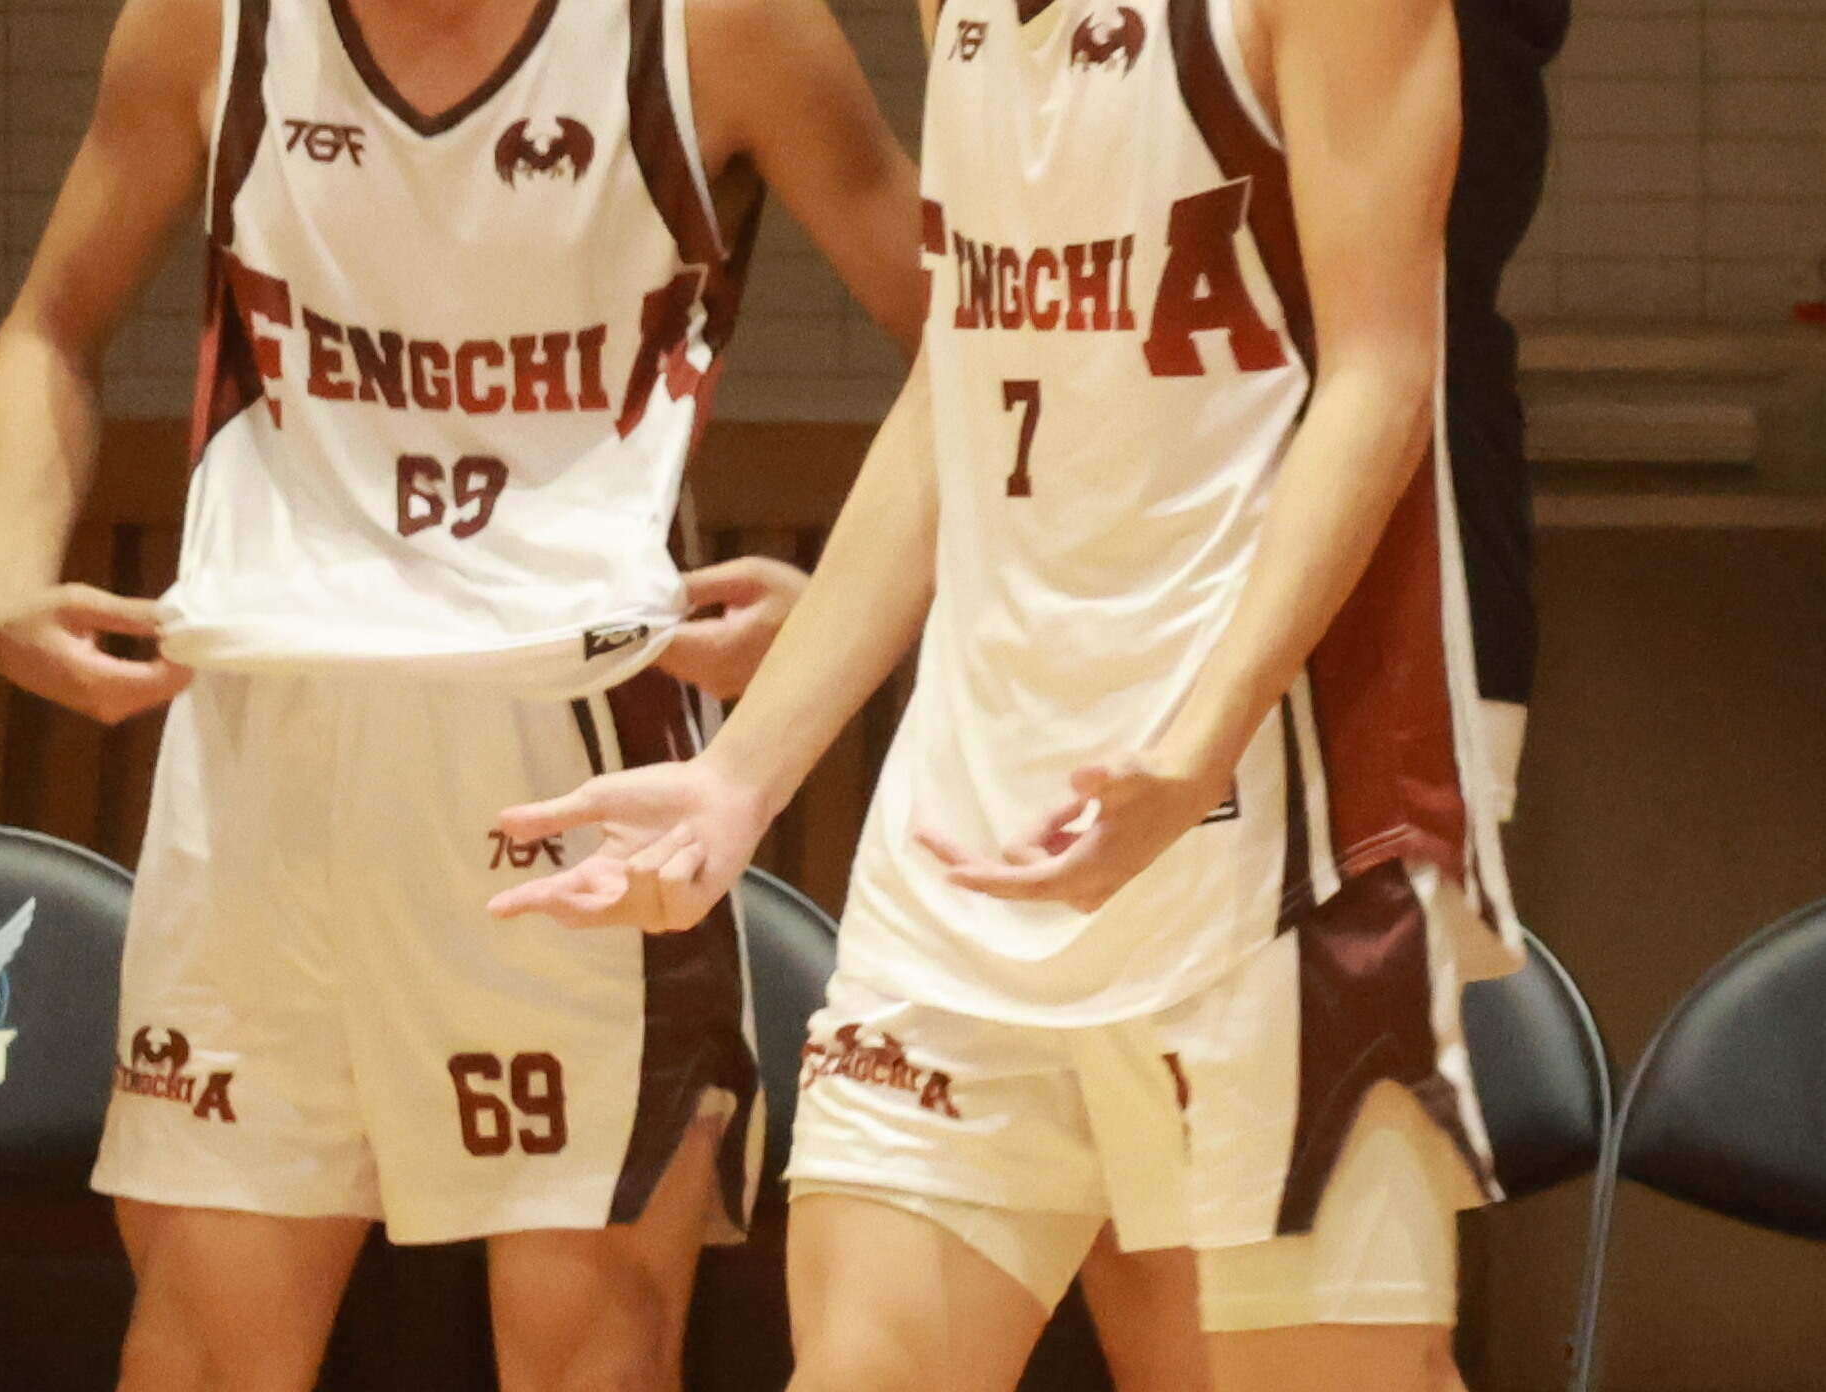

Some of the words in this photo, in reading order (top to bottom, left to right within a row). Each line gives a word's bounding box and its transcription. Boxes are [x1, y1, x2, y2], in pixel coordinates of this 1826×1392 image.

[1002, 379, 1041, 498] 7
[395, 453, 509, 539] 69
[448, 1051, 568, 1158] 69
